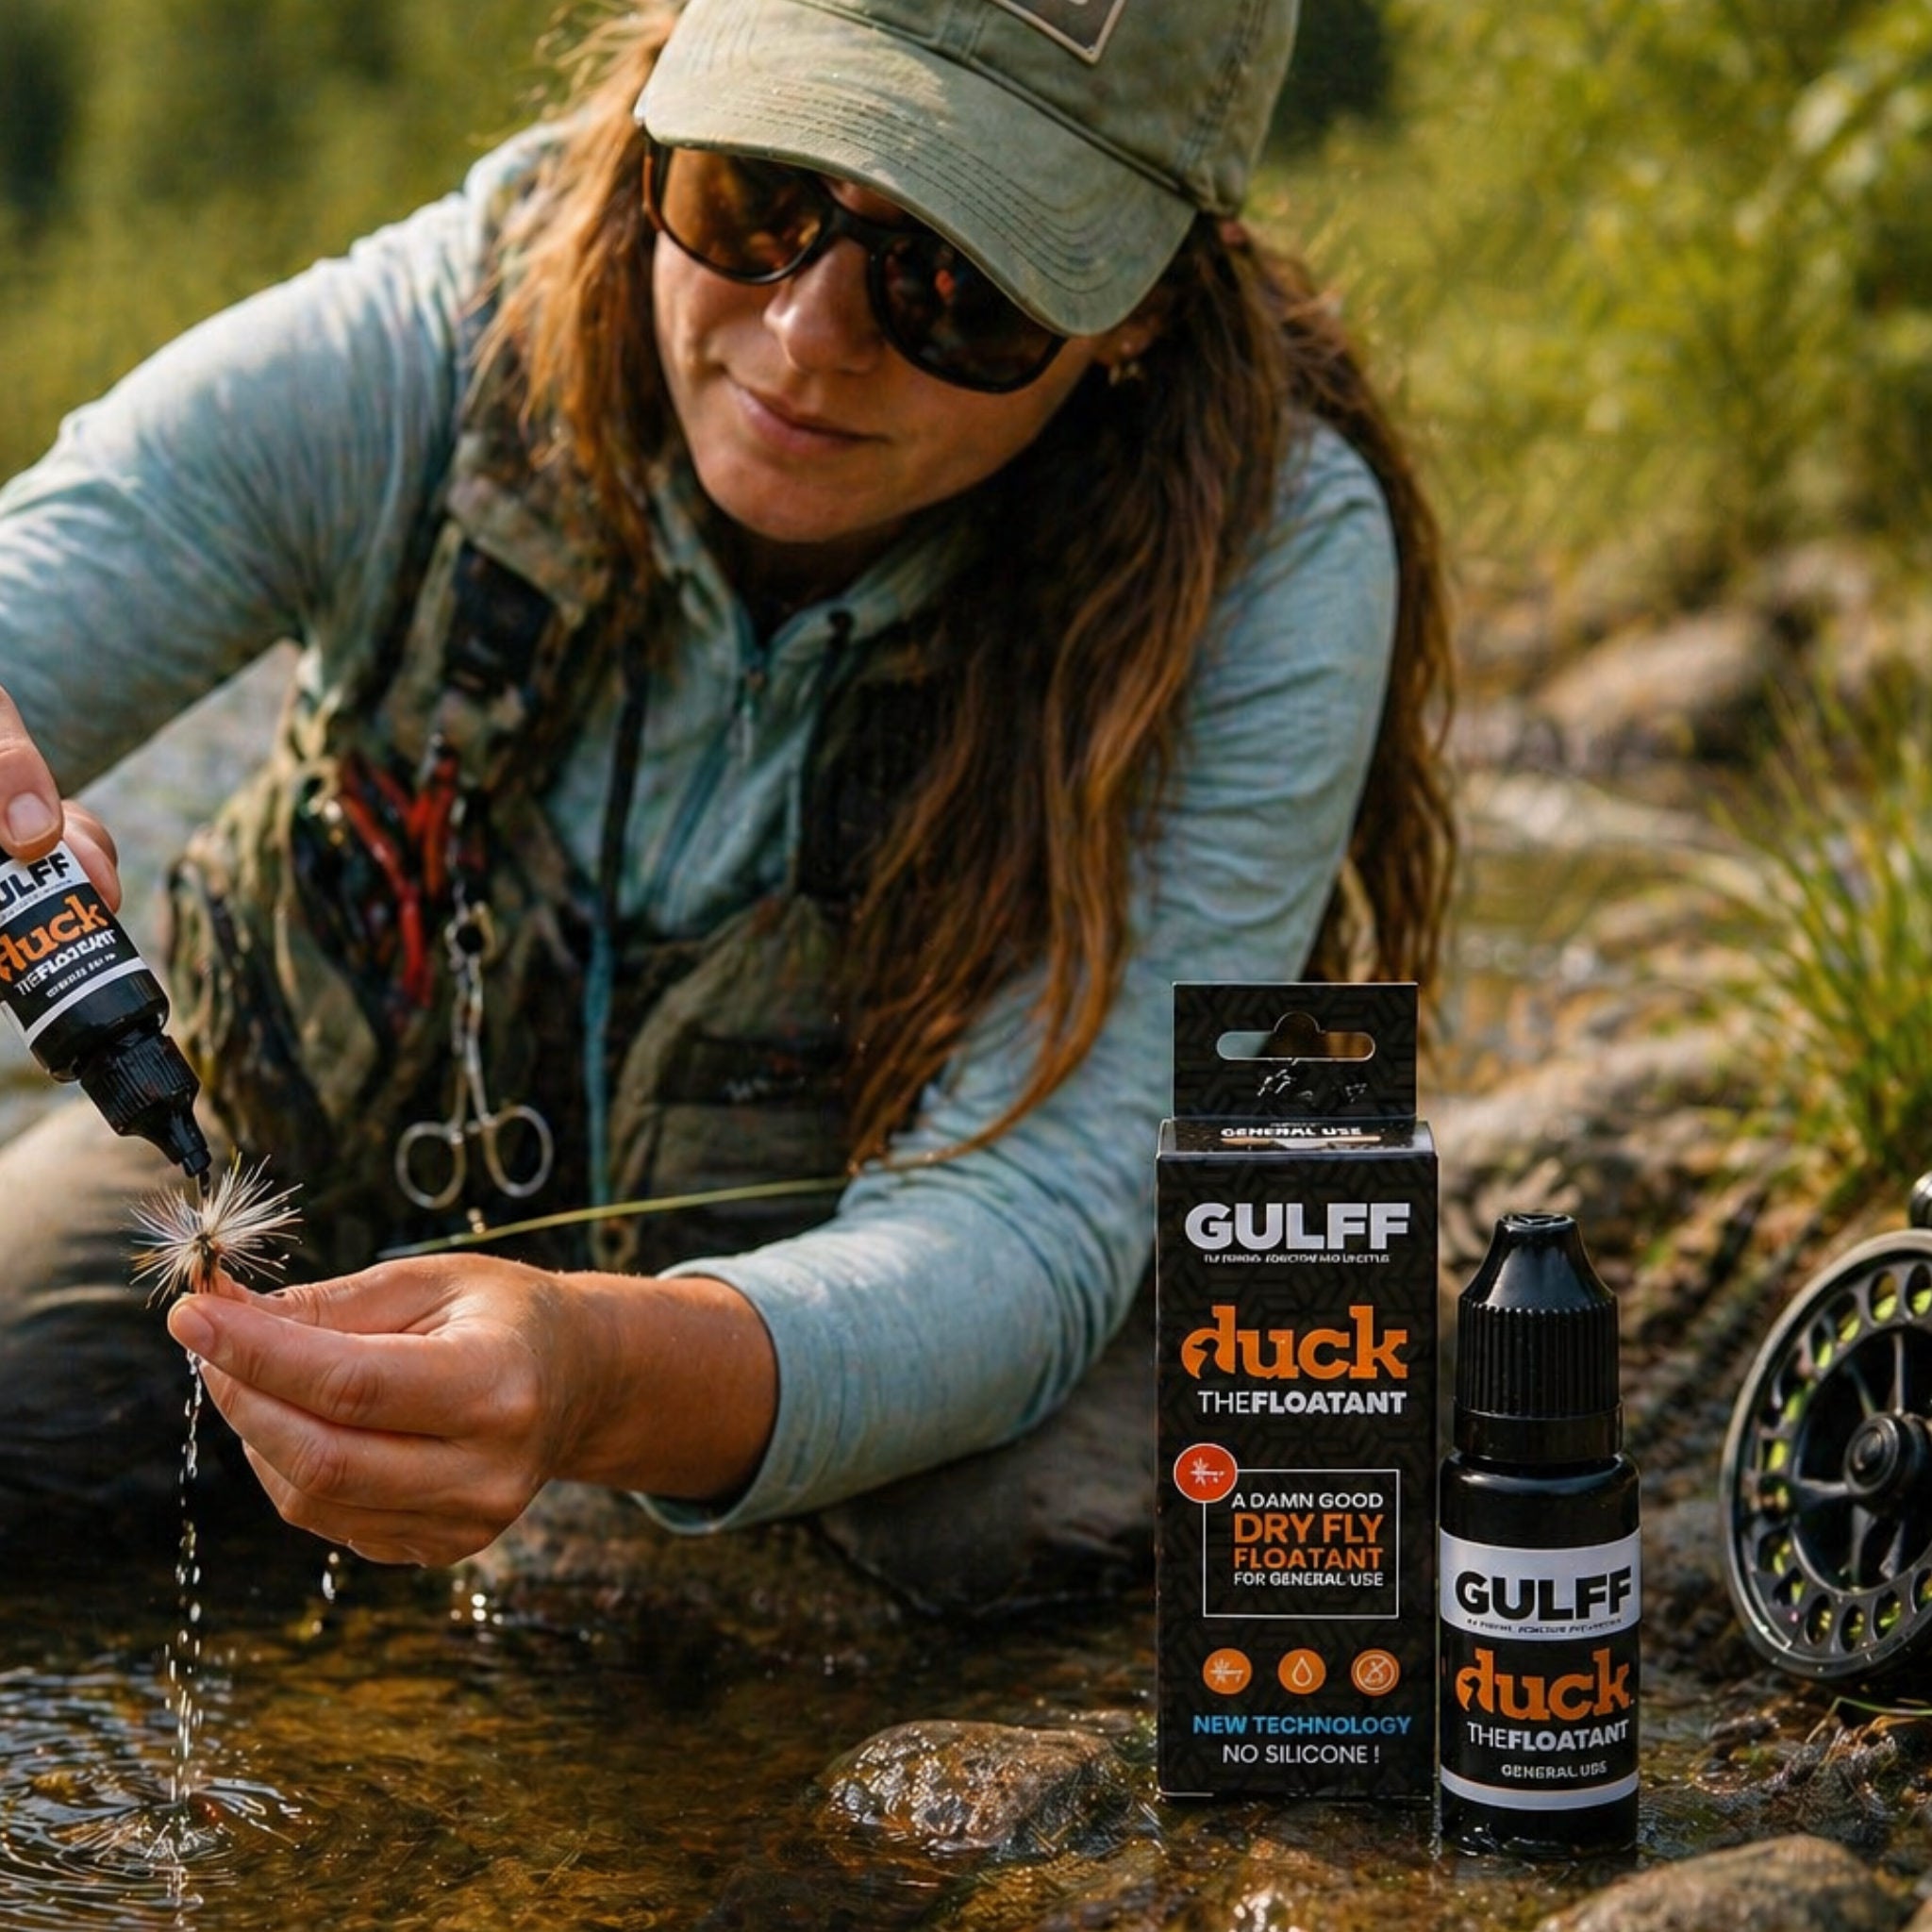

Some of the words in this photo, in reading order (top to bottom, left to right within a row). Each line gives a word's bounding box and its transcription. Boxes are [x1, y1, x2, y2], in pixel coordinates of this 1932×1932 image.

[0, 852, 70, 907] ULFF
[1185, 1203, 1409, 1250] GULFF
[1181, 1306, 1407, 1379] duck
[1198, 1391, 1407, 1413] THEFLOATANT
[1231, 1492, 1246, 1508] A
[1251, 1493, 1313, 1507] DAMN
[1319, 1493, 1383, 1507] GOOD
[1235, 1513, 1314, 1542] DRY
[1324, 1514, 1383, 1542] FLY
[1235, 1548, 1383, 1569] FLOATANT
[1235, 1572, 1265, 1585] FOR
[1270, 1572, 1345, 1586] GENERAL
[1351, 1573, 1383, 1586] USE
[1456, 1566, 1632, 1621] GULFF
[1456, 1648, 1631, 1721] duck
[1194, 1716, 1247, 1733] NEW
[1253, 1717, 1409, 1734] TECHNOLOGY
[1466, 1720, 1629, 1752] THEFLOATANT
[1224, 1745, 1258, 1762] NO
[1266, 1745, 1367, 1763] SILICONE
[1374, 1745, 1380, 1763] !
